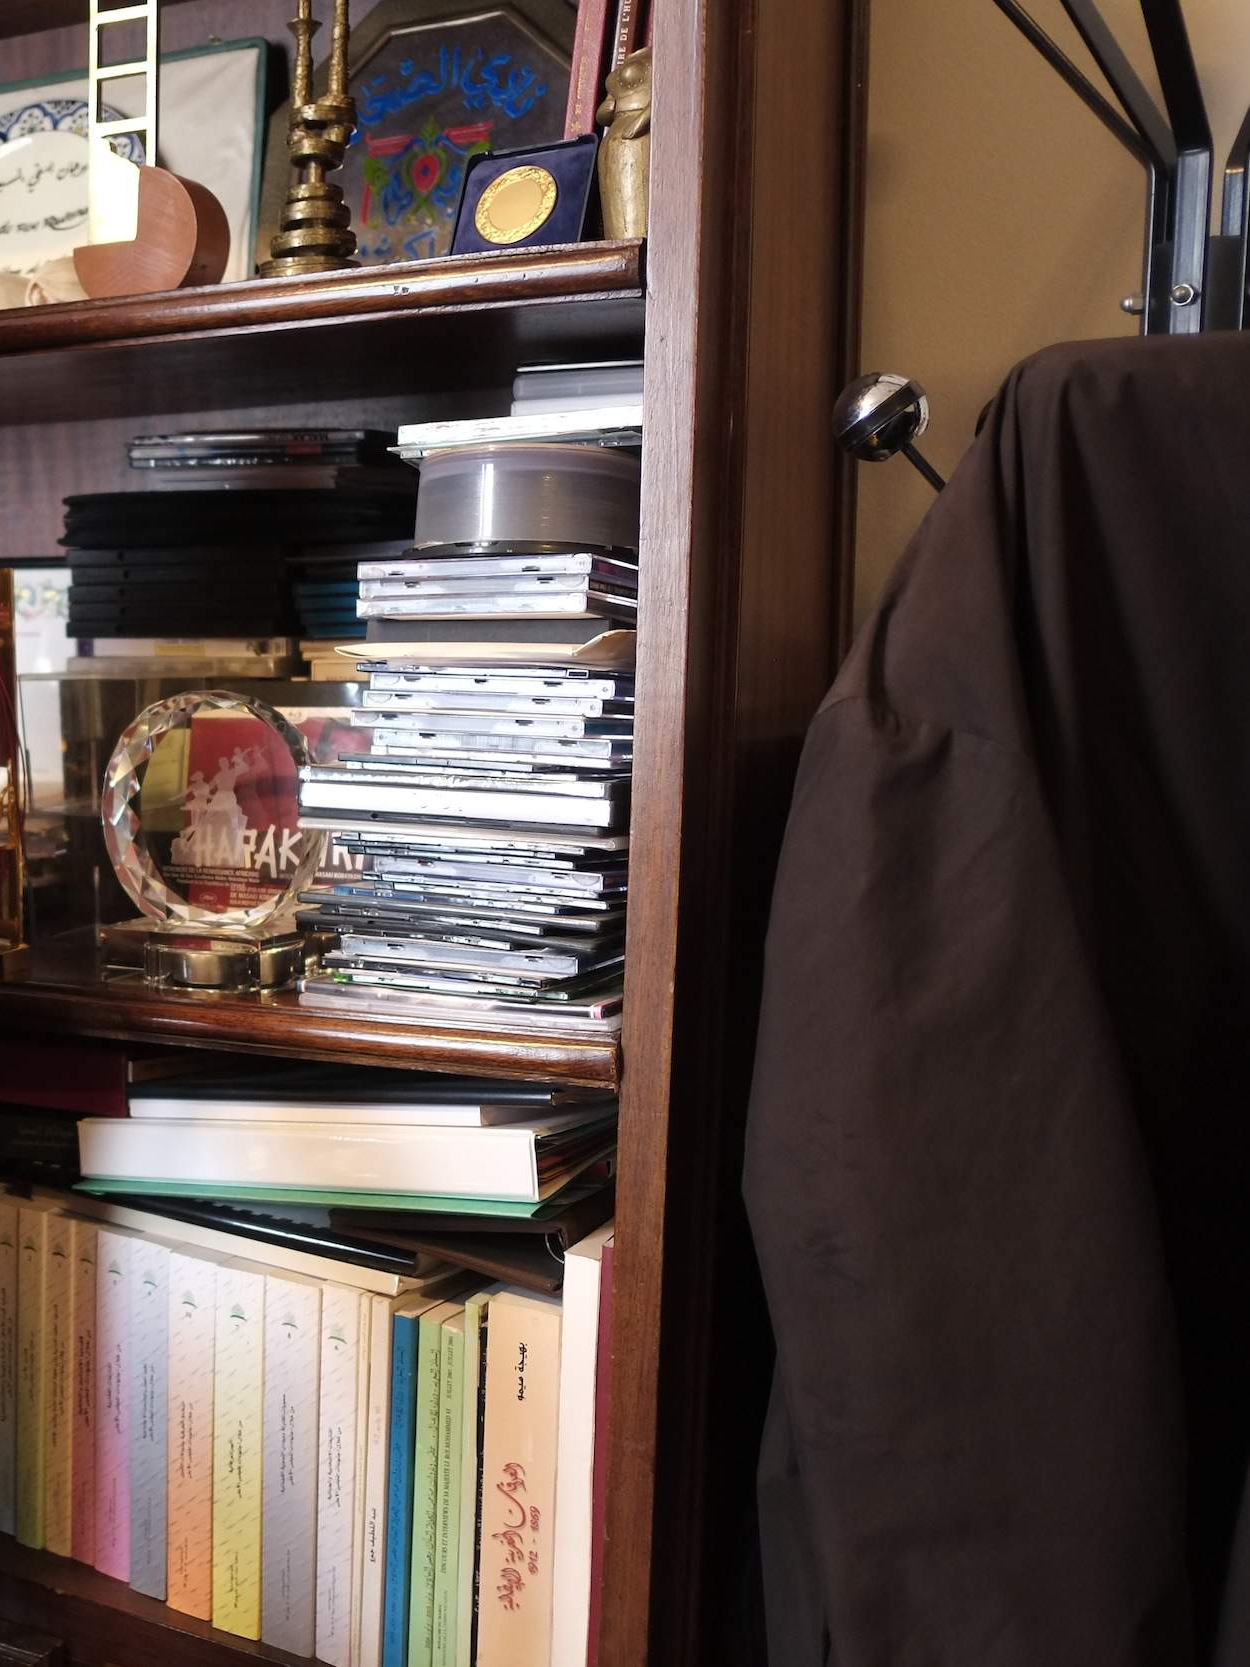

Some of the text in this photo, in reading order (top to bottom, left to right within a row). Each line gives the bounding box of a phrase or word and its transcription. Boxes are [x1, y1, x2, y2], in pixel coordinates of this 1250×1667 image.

[620, 27, 629, 41] DE
[616, 46, 627, 65] IRE
[514, 1342, 528, 1373] بهيجة
[527, 1550, 539, 1575] 1912
